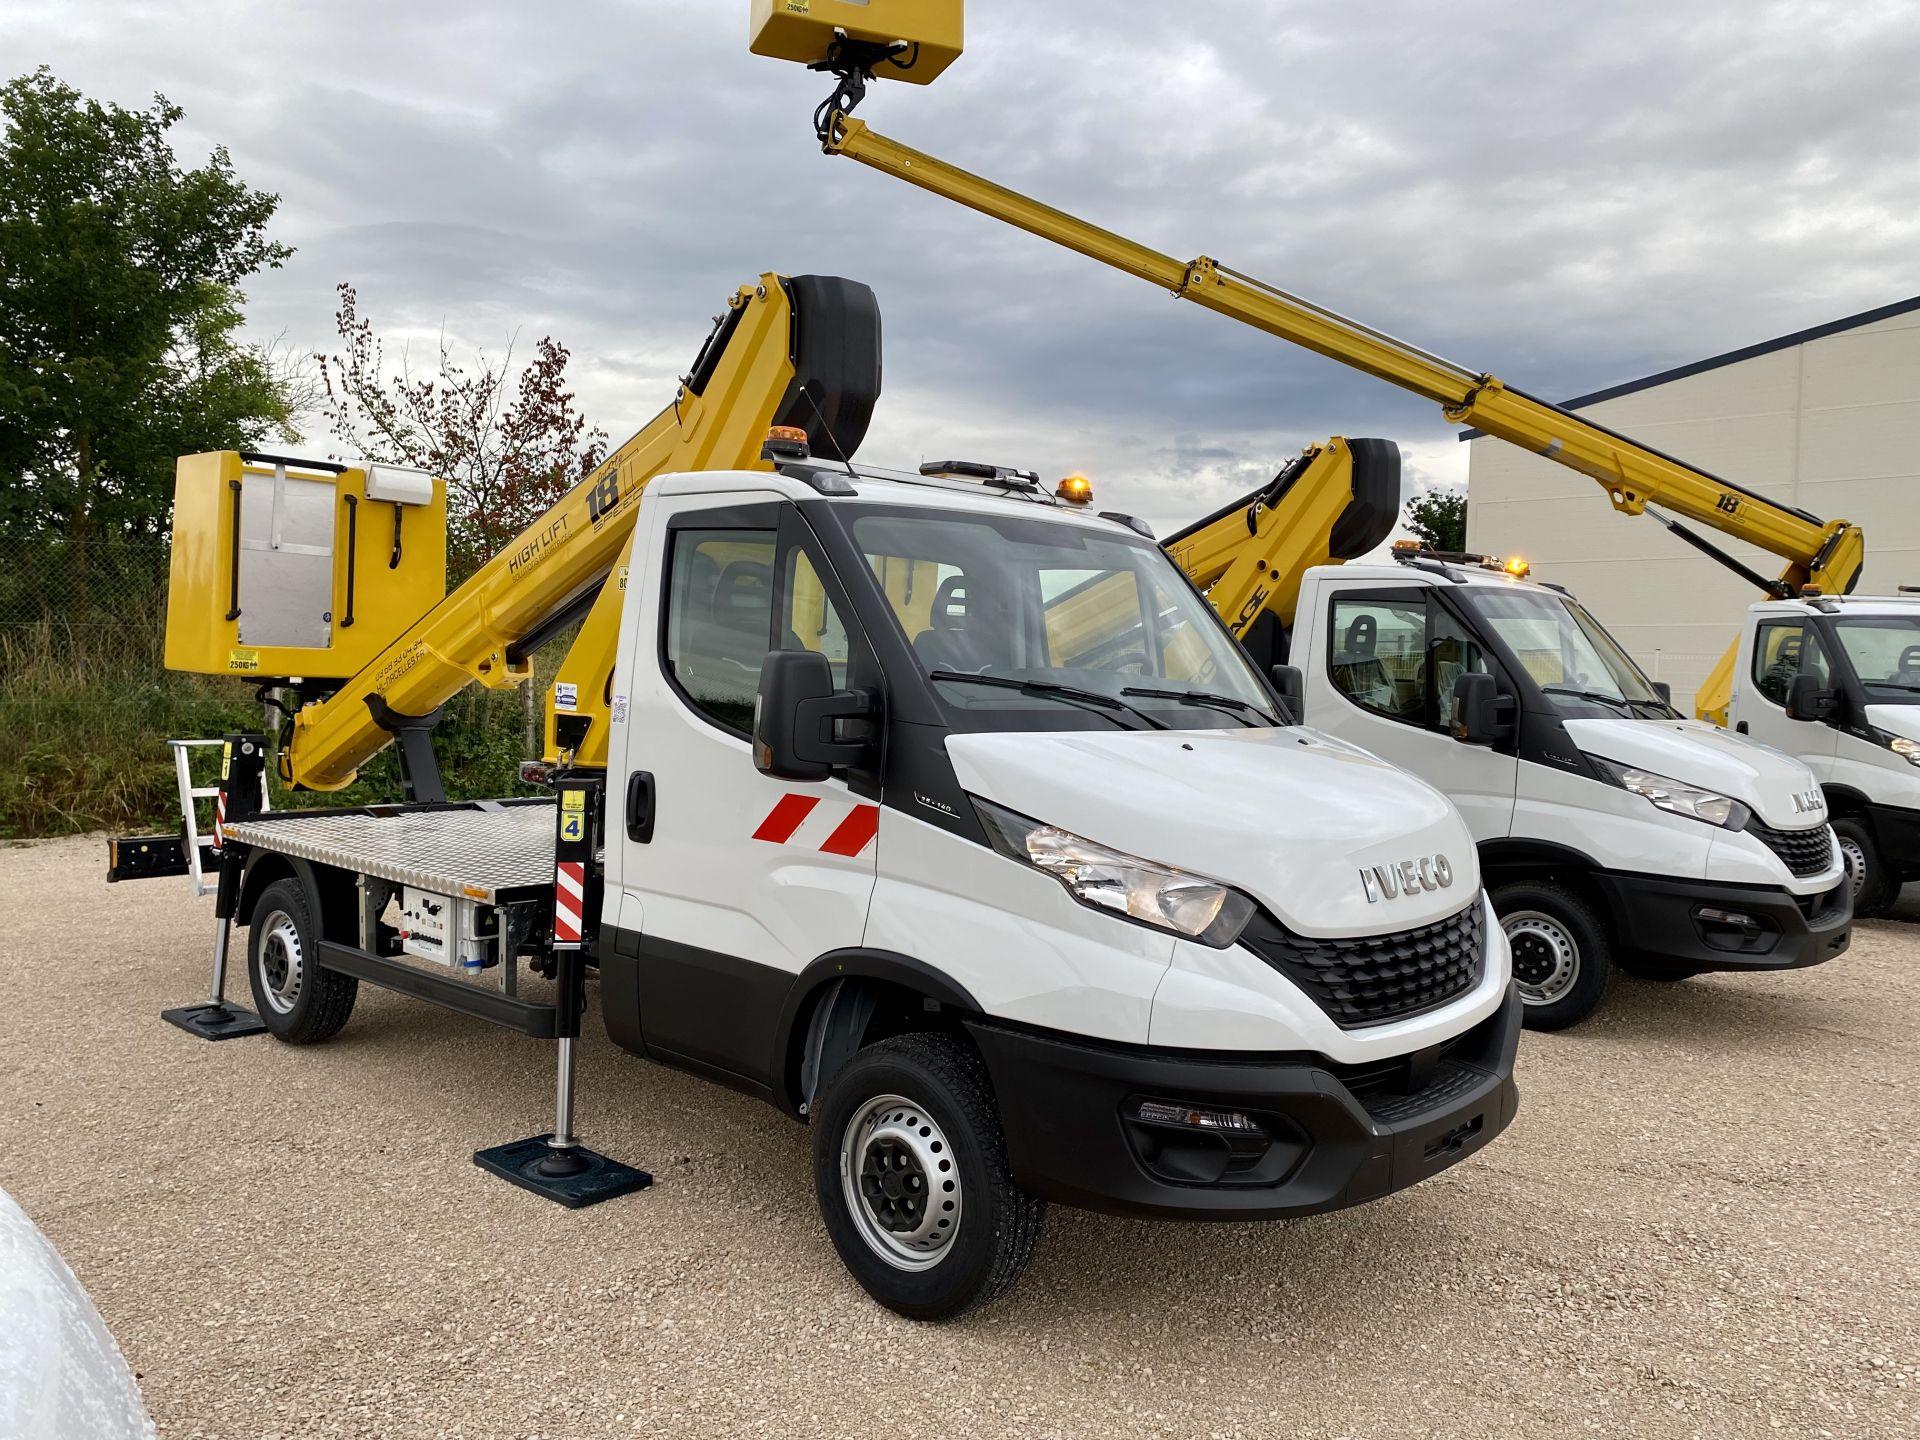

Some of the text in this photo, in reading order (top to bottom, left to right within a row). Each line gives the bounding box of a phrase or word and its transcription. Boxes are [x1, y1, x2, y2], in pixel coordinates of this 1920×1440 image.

[509, 513, 568, 574] HIGH LIFT
[565, 820, 579, 836] 4
[1359, 854, 1453, 903] IVECO
